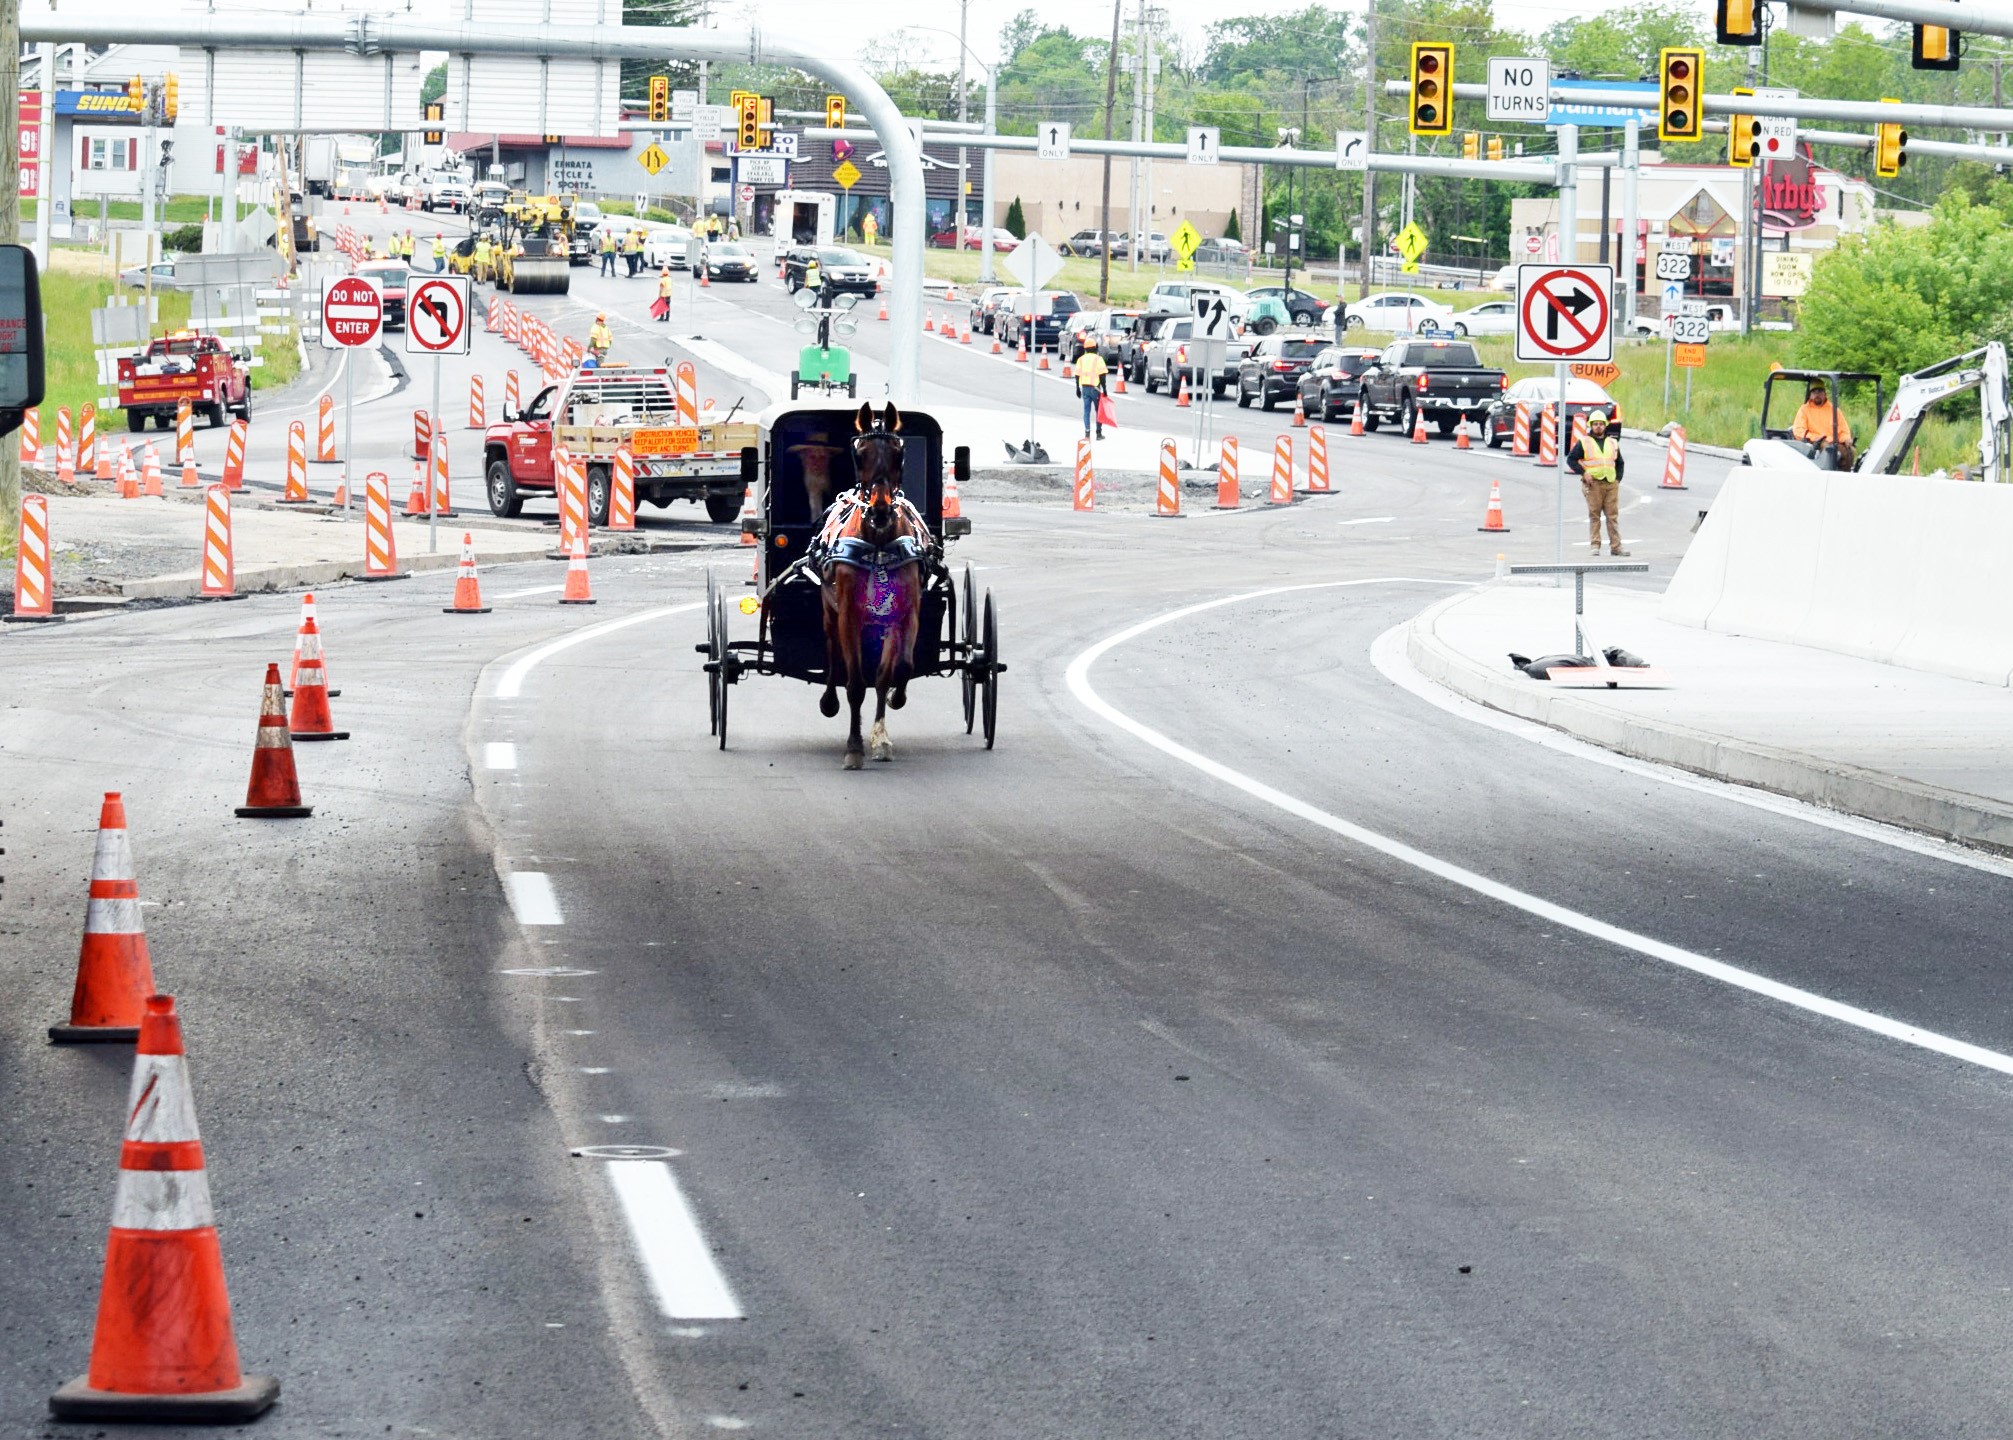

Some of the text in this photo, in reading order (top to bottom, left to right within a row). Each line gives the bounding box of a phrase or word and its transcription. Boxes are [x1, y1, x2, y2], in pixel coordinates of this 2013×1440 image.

[1504, 68, 1534, 87] NO
[76, 95, 147, 113] SUNO
[1493, 95, 1545, 111] TURNS
[1774, 127, 1792, 136] RED
[1042, 149, 1065, 158] ONLY
[1191, 154, 1214, 163] ONLY
[1340, 158, 1363, 168] ONLY
[555, 160, 593, 169] EPHRATA
[554, 170, 582, 179] CYCLE
[557, 181, 590, 190] SPORTS
[1754, 174, 1827, 219] Arby's
[1665, 241, 1686, 250] WEST
[1660, 258, 1688, 274] 322
[333, 290, 374, 303] DO NOT
[1682, 303, 1703, 313] WEST
[335, 321, 369, 335] ENTER
[1675, 321, 1706, 338] 322
[1678, 355, 1702, 363] DETOUR
[1575, 363, 1615, 378] BUMP
[634, 429, 696, 438] CONSTRUCTION VEHICLE
[676, 437, 697, 445] SUDDEN
[641, 445, 657, 453] STOPS
[672, 444, 690, 452] TURNS
